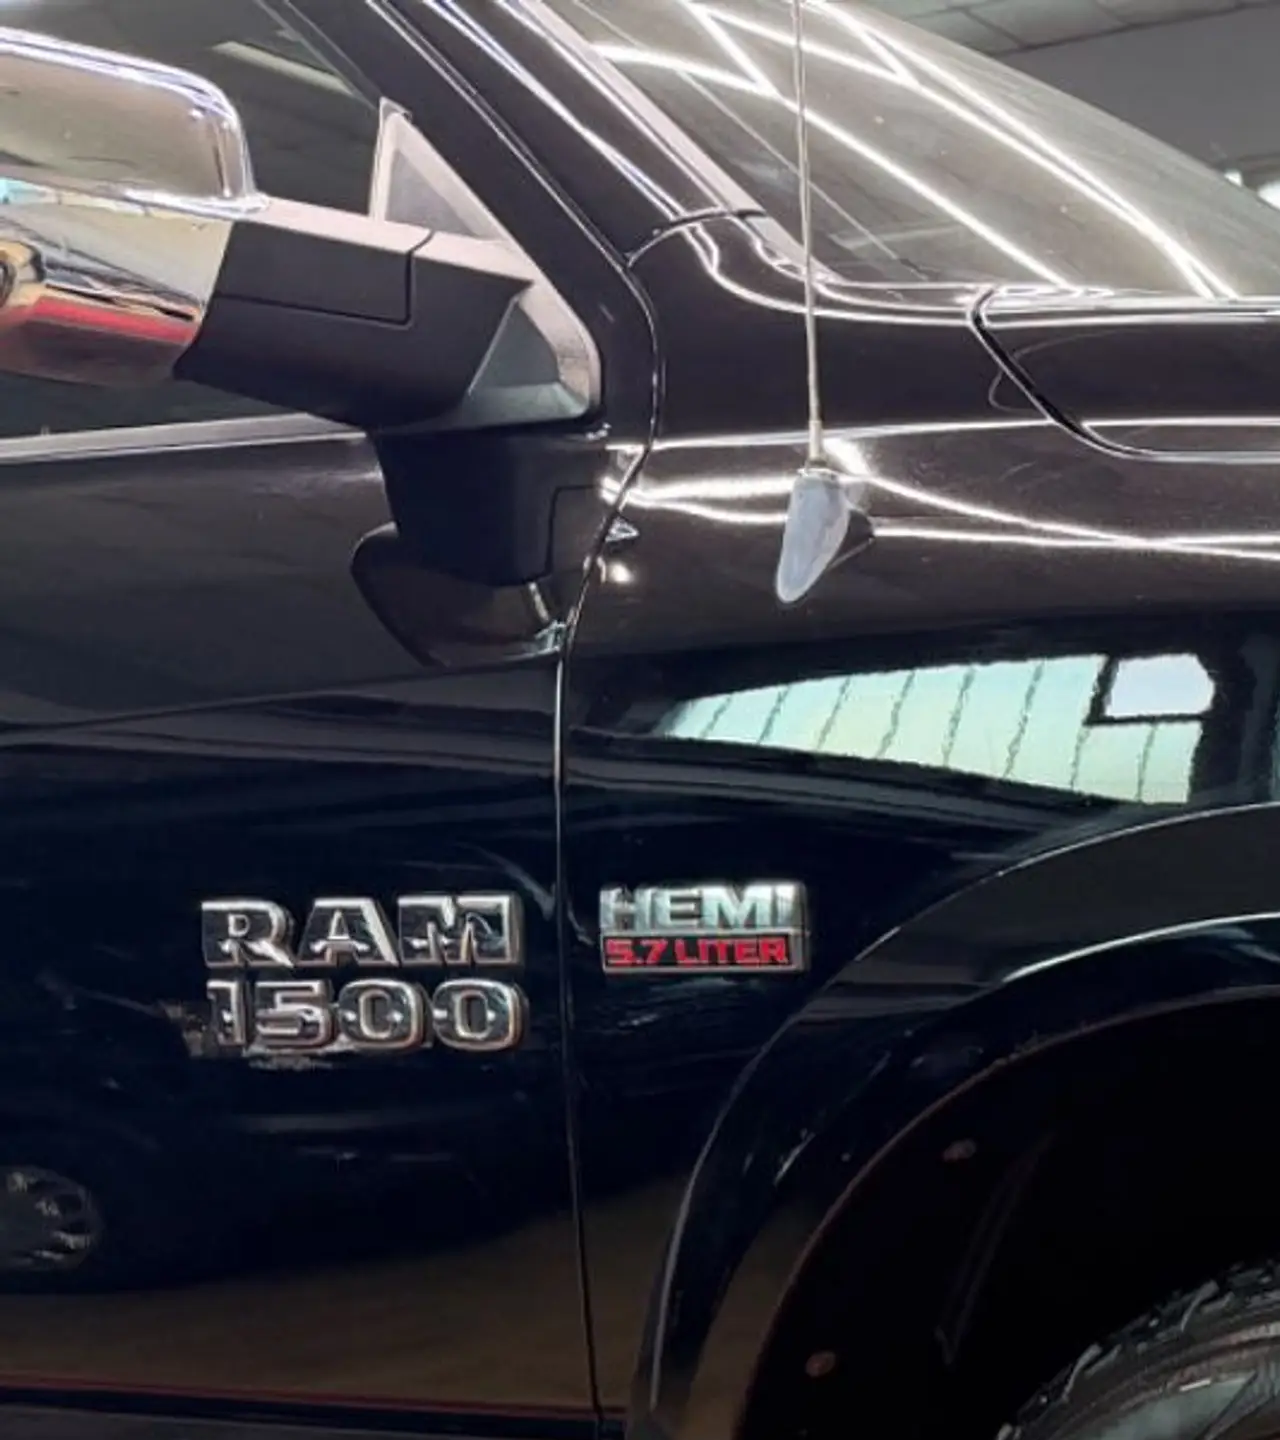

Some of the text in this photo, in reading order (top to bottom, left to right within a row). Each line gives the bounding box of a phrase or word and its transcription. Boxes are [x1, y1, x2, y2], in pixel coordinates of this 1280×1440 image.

[200, 894, 521, 968] RAM
[599, 883, 804, 930] HEMI
[605, 937, 789, 966] 5.7 LITER
[206, 978, 526, 1050] 1500
